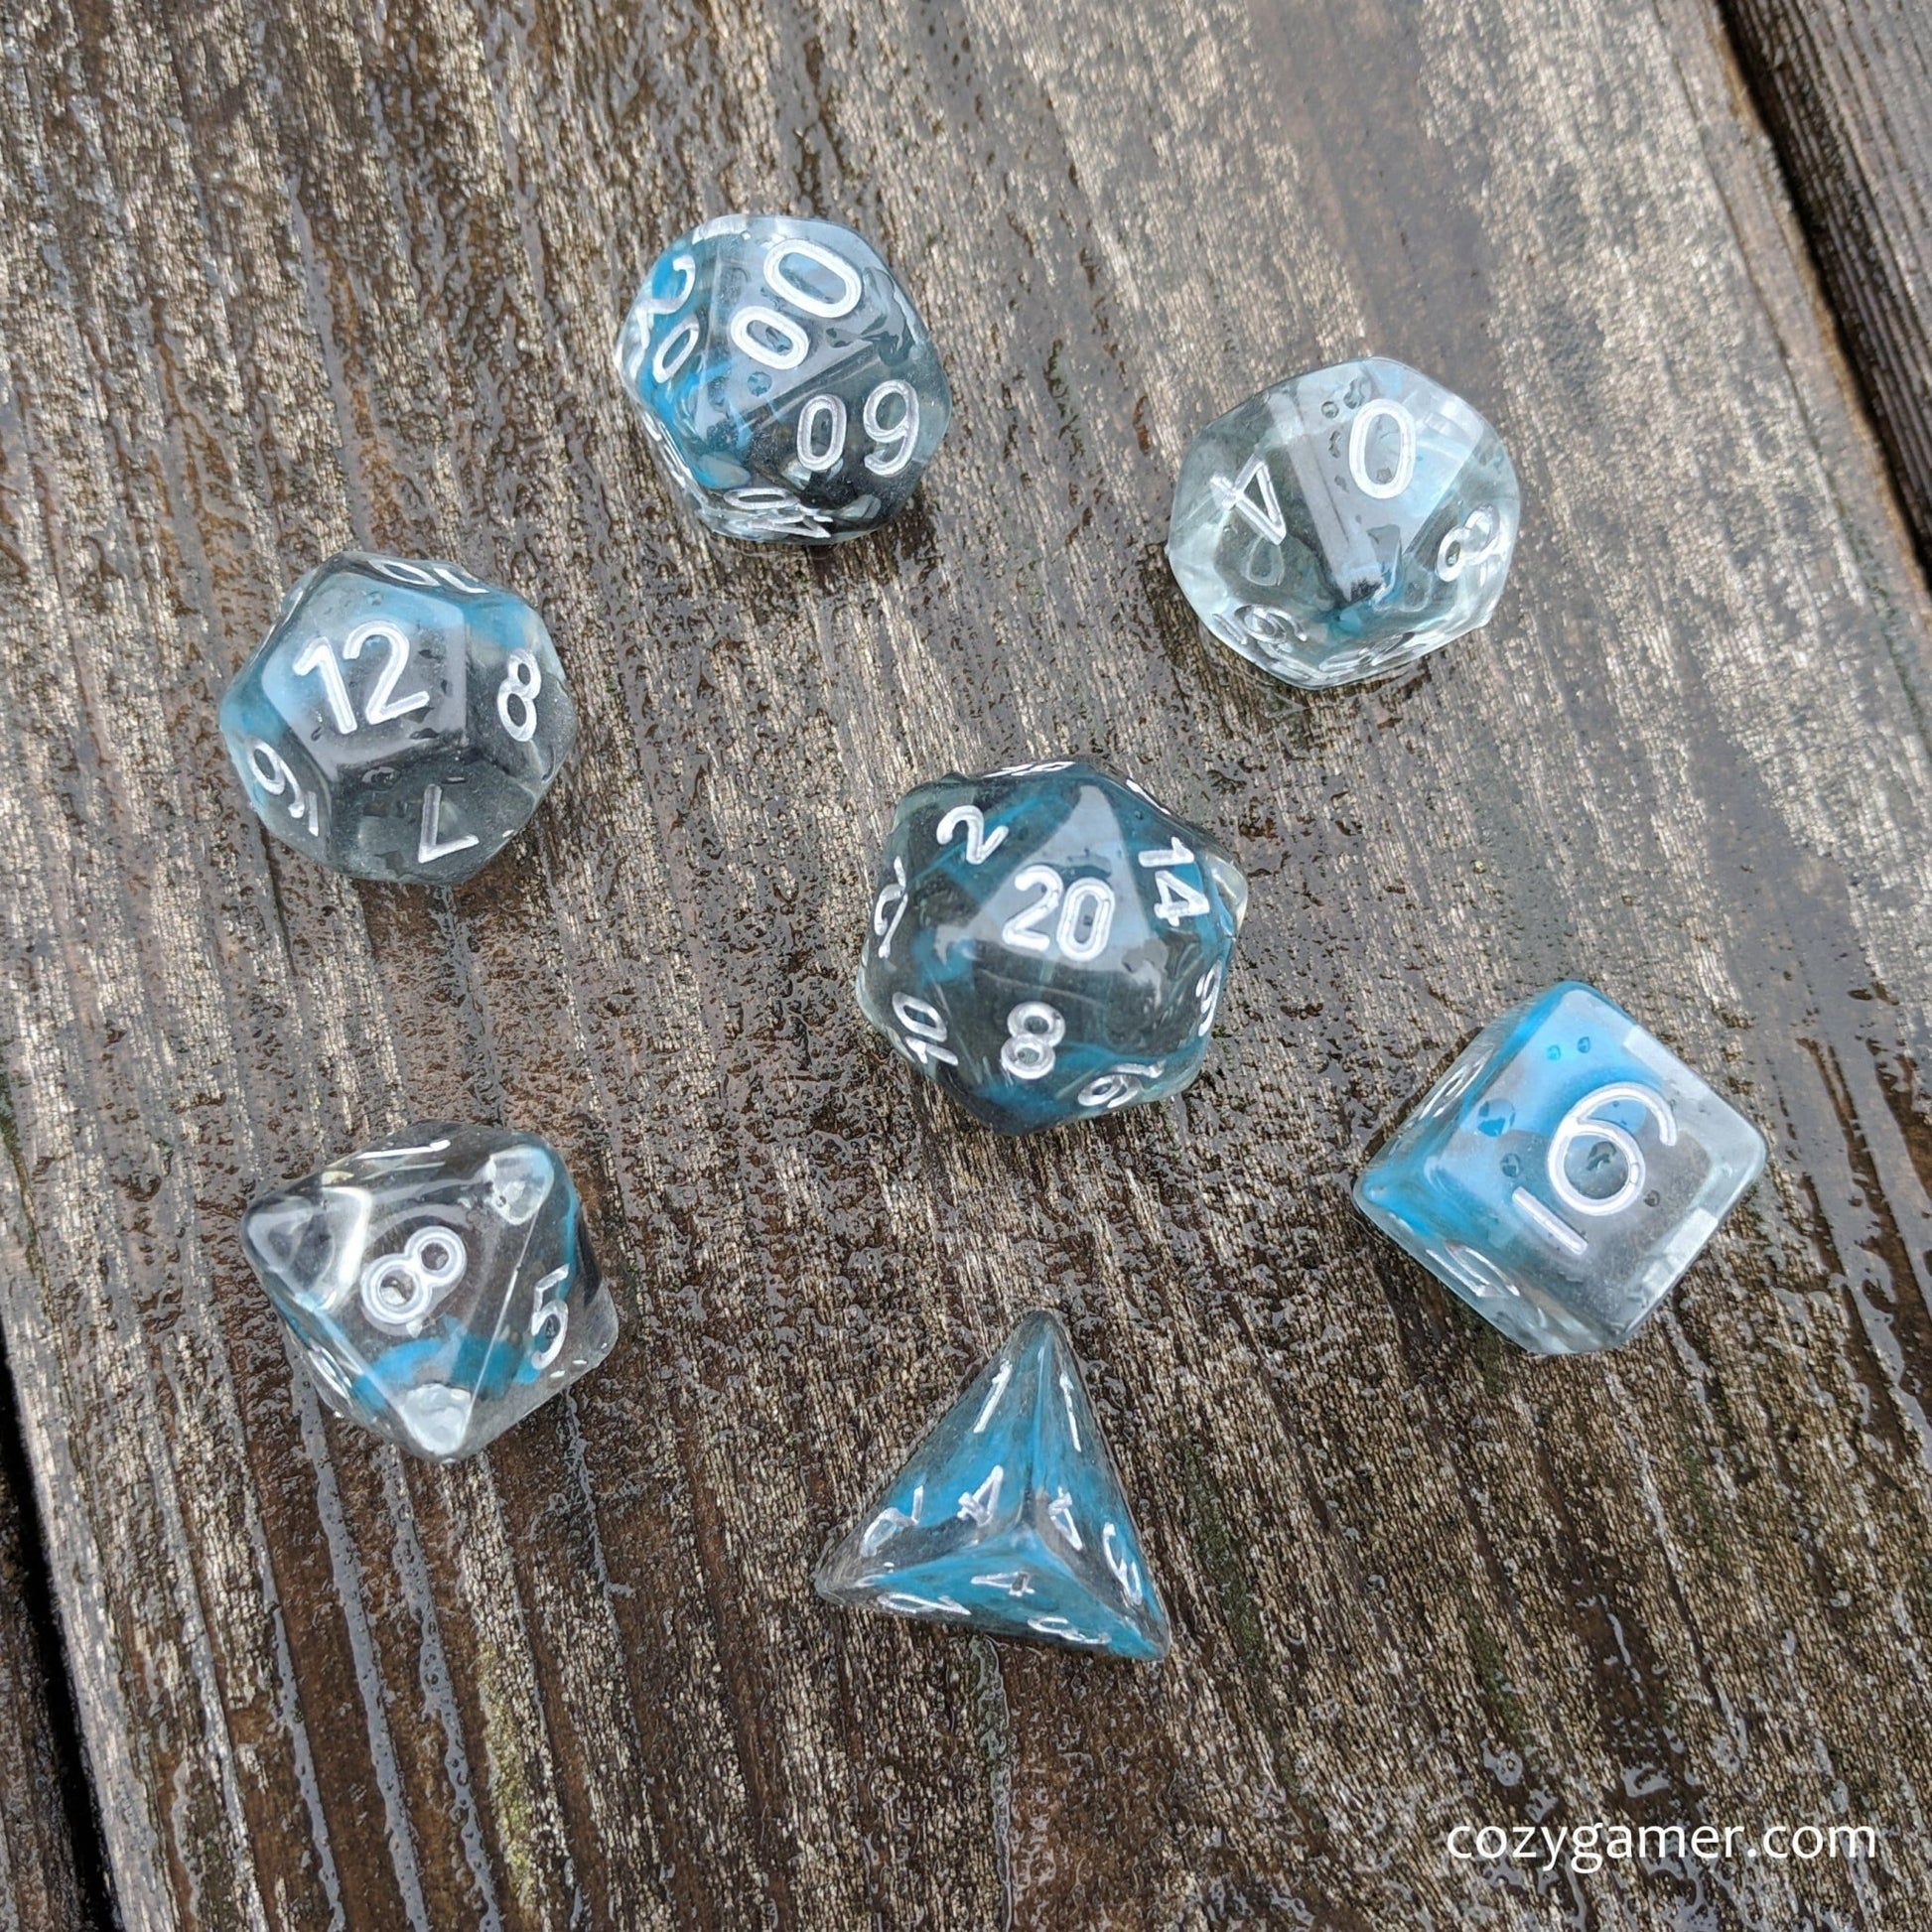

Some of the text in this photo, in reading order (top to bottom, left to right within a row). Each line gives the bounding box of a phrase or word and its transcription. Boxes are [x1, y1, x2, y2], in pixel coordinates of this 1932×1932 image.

[730, 237, 863, 370] 00
[1348, 398, 1417, 499] 0
[1209, 453, 1288, 545] 4
[1436, 503, 1501, 583] 8
[292, 620, 431, 735] 12
[496, 648, 543, 743] 8
[417, 783, 481, 864] 7
[935, 804, 1010, 865] 2
[1001, 864, 1116, 962] 20
[1138, 836, 1210, 926] 14
[895, 992, 959, 1067] 10
[1001, 1001, 1066, 1080] 8
[360, 1225, 468, 1324] 8
[529, 1263, 571, 1370] 5
[973, 1359, 1013, 1434] 1
[956, 1464, 1005, 1528] 4
